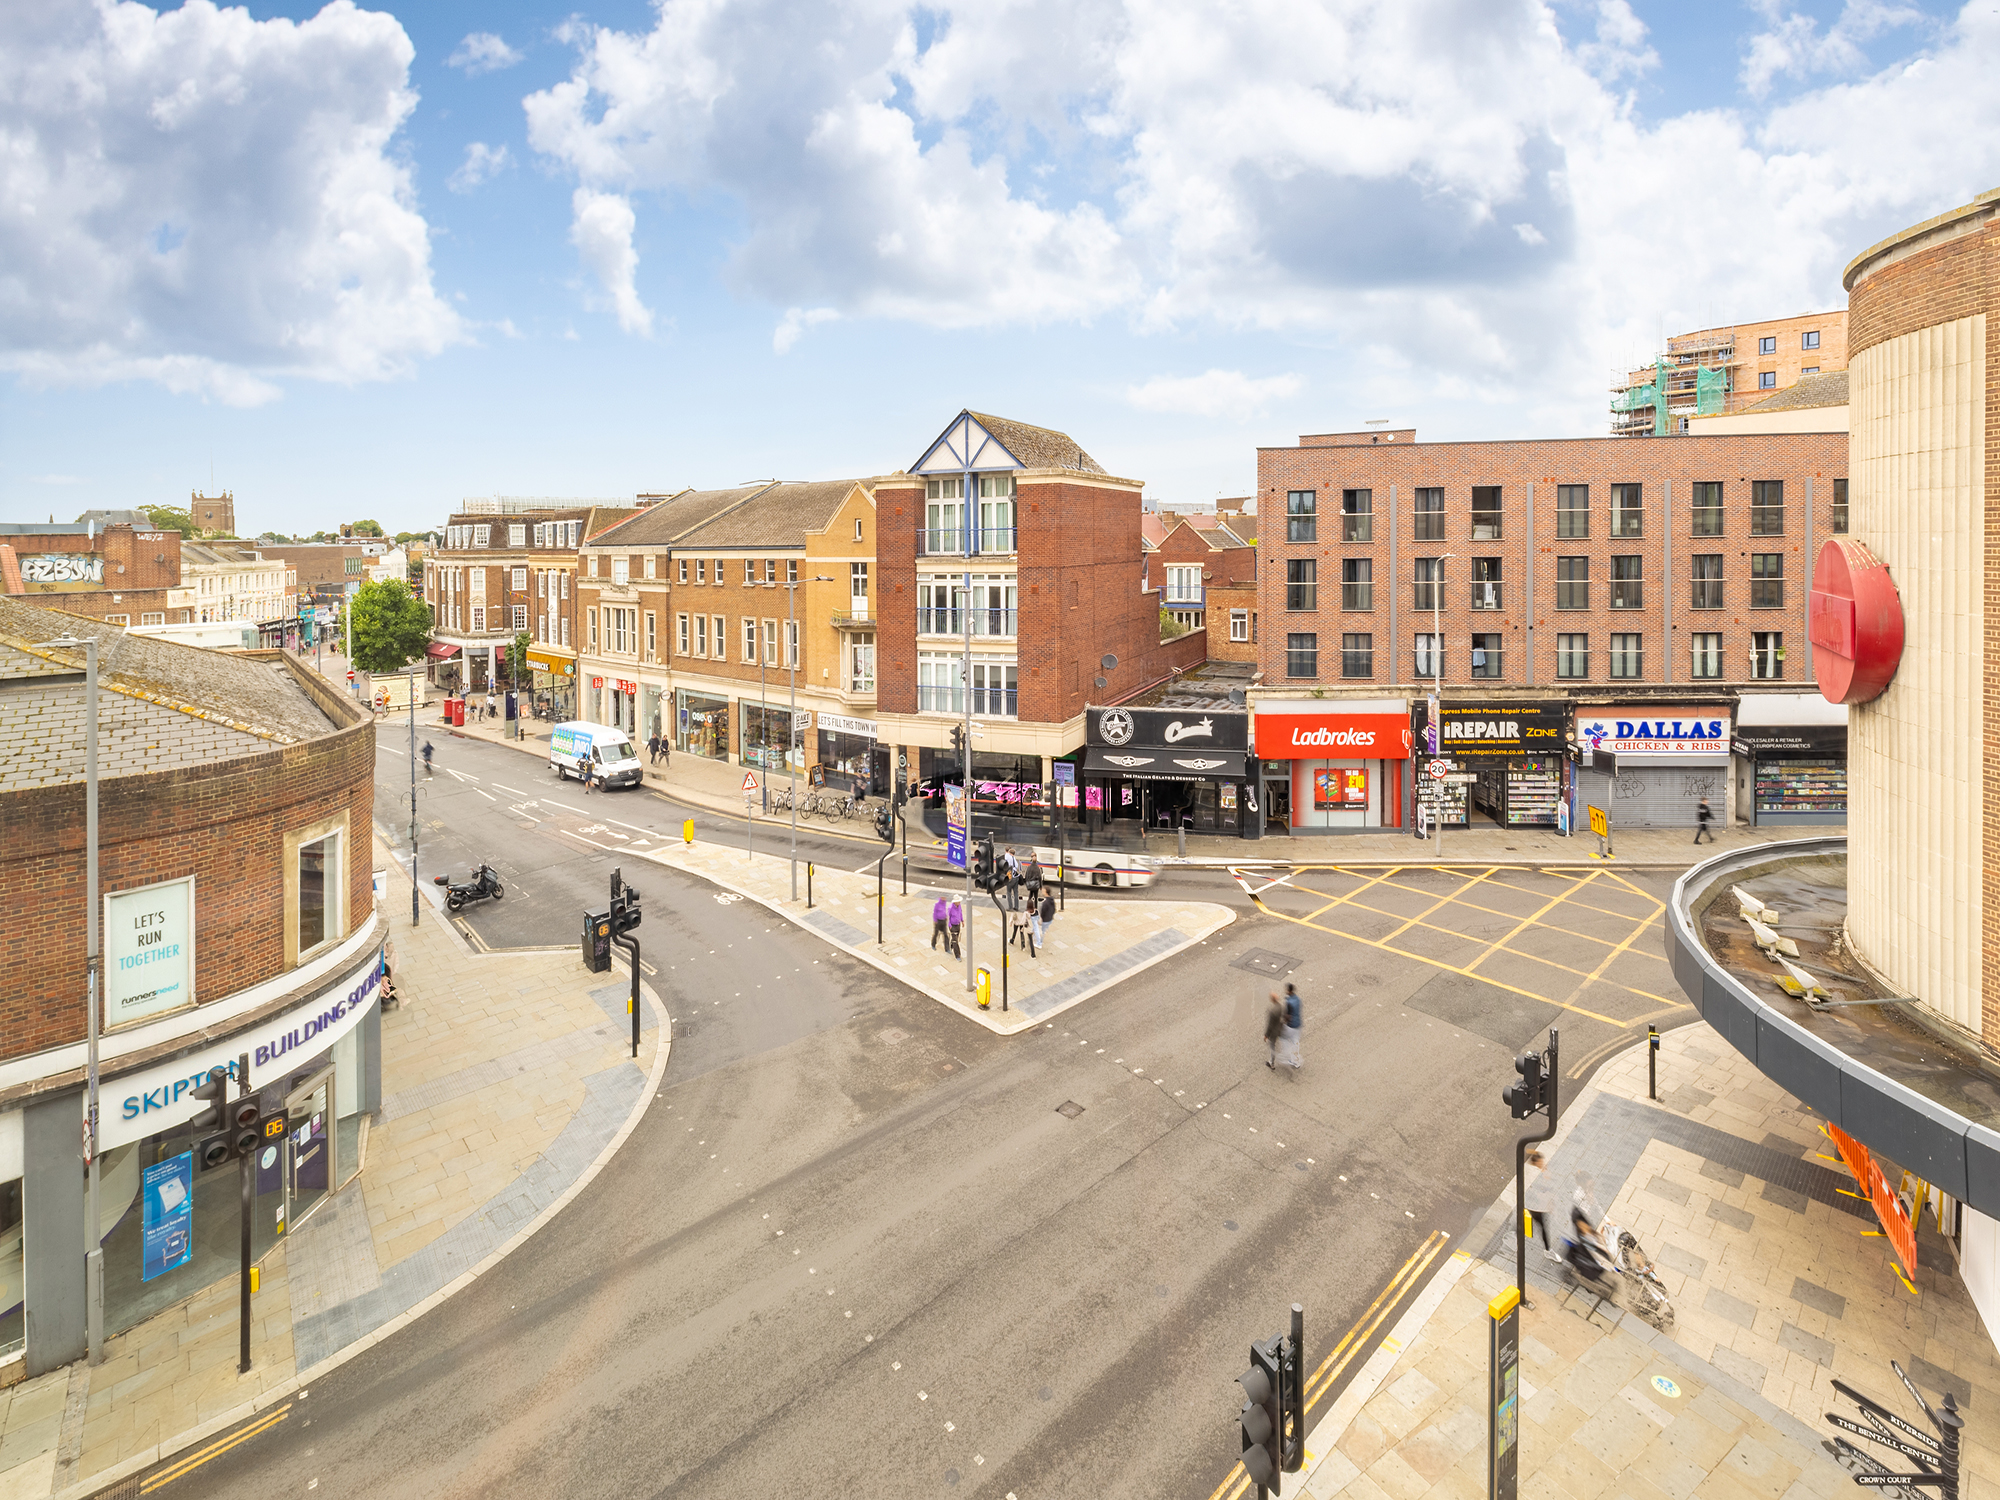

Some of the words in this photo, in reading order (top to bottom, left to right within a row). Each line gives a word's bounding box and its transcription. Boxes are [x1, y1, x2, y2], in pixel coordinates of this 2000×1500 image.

[526, 660, 549, 671] STARBUCKS
[818, 714, 831, 727] LET'S
[831, 717, 842, 728] FILL
[843, 719, 854, 730] THIS
[855, 721, 869, 733] TOWN
[1444, 721, 1520, 738] iREPAIR
[1526, 728, 1557, 737] ZONE
[1615, 721, 1723, 739] DALLAS
[1291, 727, 1376, 746] Ladbrokes
[1615, 742, 1670, 750] CHICKEN
[1691, 742, 1721, 750] RIBS
[1431, 765, 1445, 774] 20
[1348, 775, 1365, 789] £10
[134, 911, 165, 930] LET'S
[138, 930, 162, 947] RUN
[119, 944, 179, 971] TOGETHER
[121, 982, 179, 1005] runnersneed
[255, 1000, 347, 1067] BUILDING
[266, 1118, 283, 1137] 06
[169, 1215, 187, 1226] loyalty
[1863, 1410, 1891, 1436] STATION
[1890, 1415, 1939, 1449] RIVERSIDE
[1837, 1418, 1857, 1431] THE
[1858, 1427, 1899, 1449] BENTALL
[1900, 1444, 1939, 1466] CENTRE
[1853, 1450, 1889, 1474] KINGSTO
[1859, 1476, 1886, 1484] CROWN
[1887, 1476, 1911, 1484] COURT
